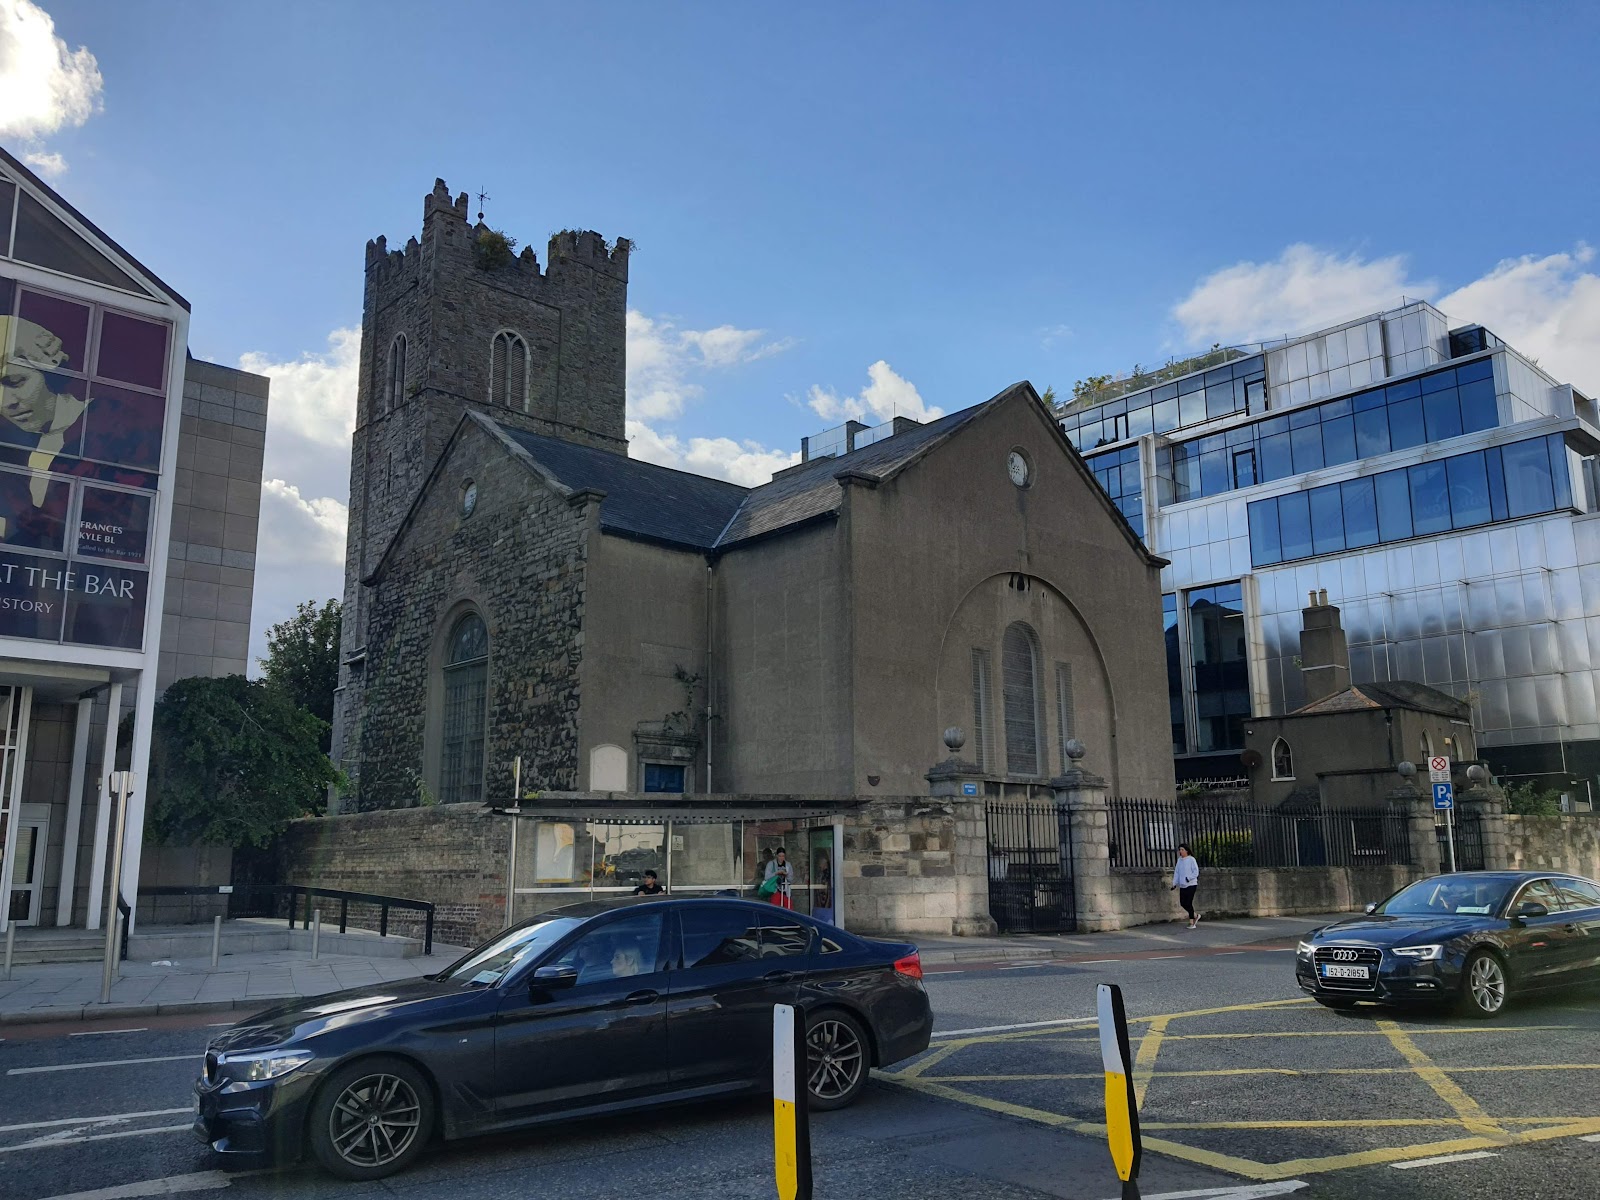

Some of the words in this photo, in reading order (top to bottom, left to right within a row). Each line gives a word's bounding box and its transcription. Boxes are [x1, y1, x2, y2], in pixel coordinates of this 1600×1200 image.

[80, 521, 122, 534] FRANCES
[79, 532, 102, 541] KYLE
[104, 535, 115, 544] BL
[0, 563, 19, 584] T
[24, 566, 76, 592] THE
[84, 574, 134, 600] BAR
[0, 597, 54, 614] STORY
[1437, 785, 1446, 798] P
